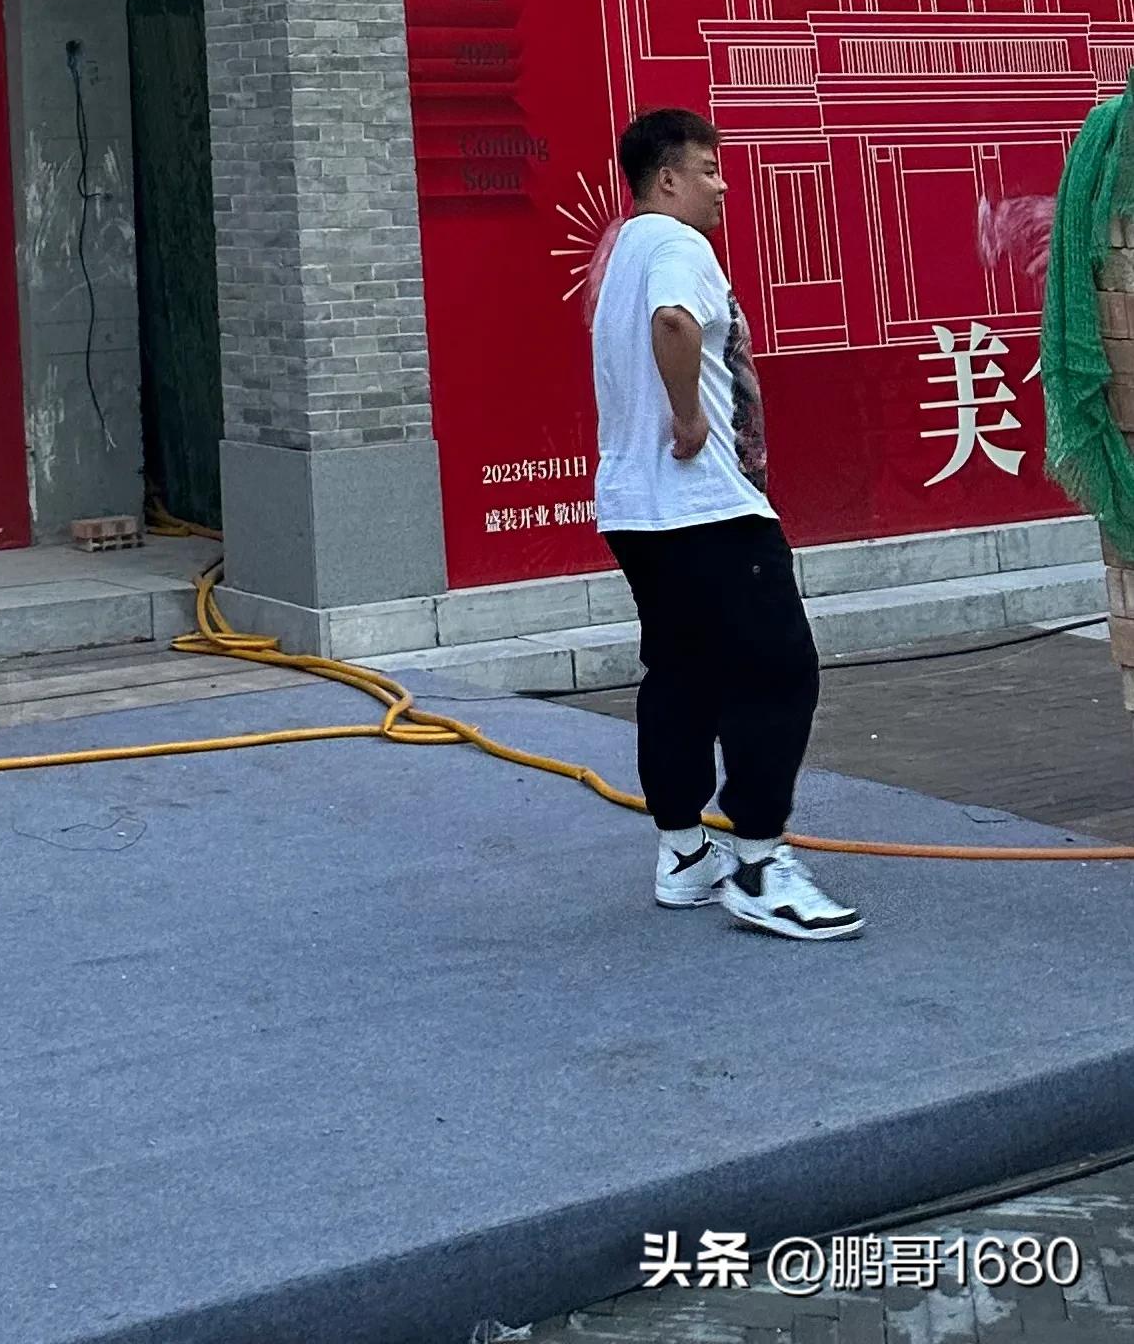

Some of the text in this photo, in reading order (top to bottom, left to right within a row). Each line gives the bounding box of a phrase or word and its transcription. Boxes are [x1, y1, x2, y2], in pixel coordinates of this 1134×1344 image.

[482, 455, 587, 485] 2023年5月1日
[485, 505, 550, 533] 盛装开业
